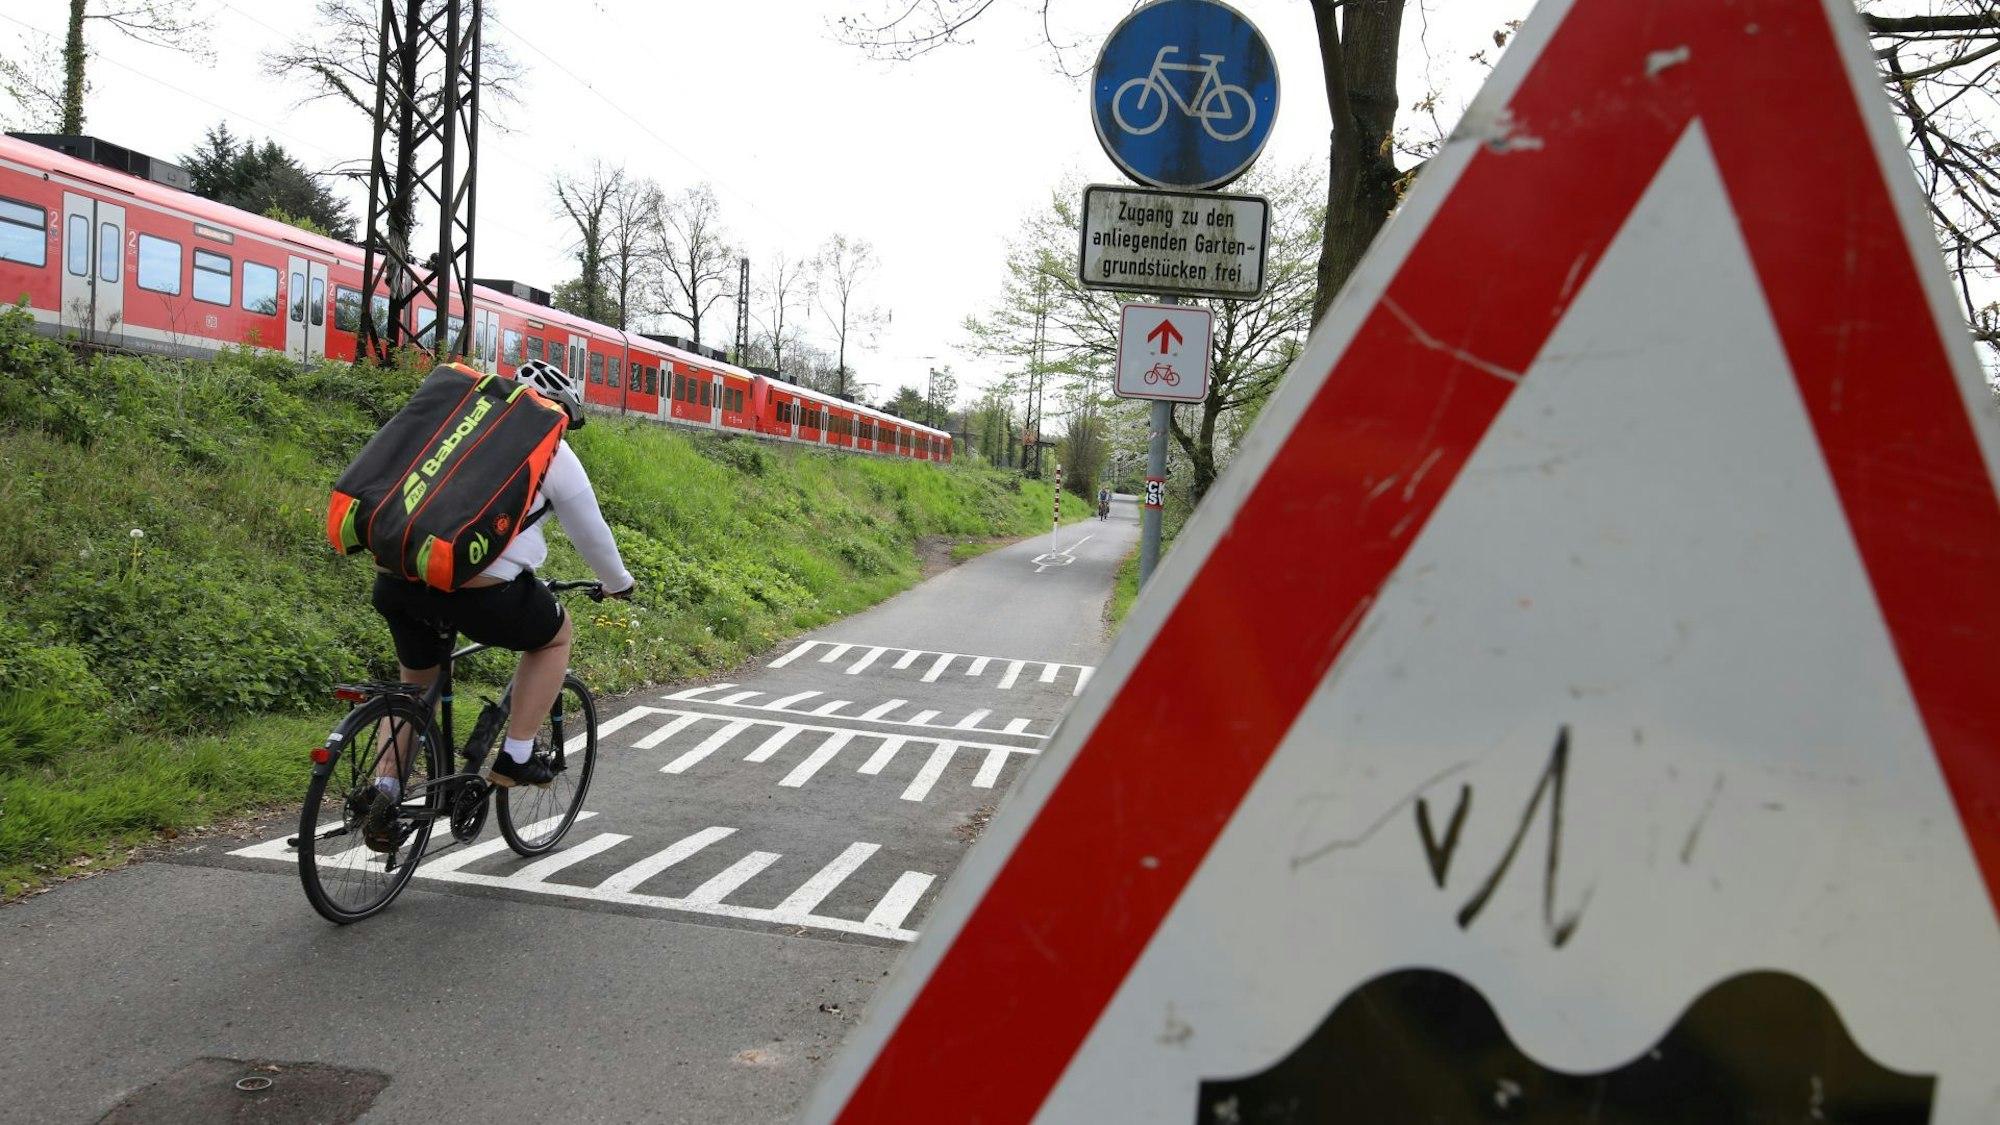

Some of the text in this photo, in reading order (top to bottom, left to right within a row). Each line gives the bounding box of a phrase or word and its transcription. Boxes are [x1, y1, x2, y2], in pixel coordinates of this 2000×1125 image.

[50, 211, 59, 228] 2
[1118, 201, 1234, 228] Zugang zu den
[128, 231, 137, 248] 2
[1093, 228, 1256, 255] anliegenden Garten-
[280, 270, 285, 284] 2
[1102, 257, 1242, 282] grundstücken frei
[329, 283, 335, 297] 2
[421, 396, 493, 478] Babolat
